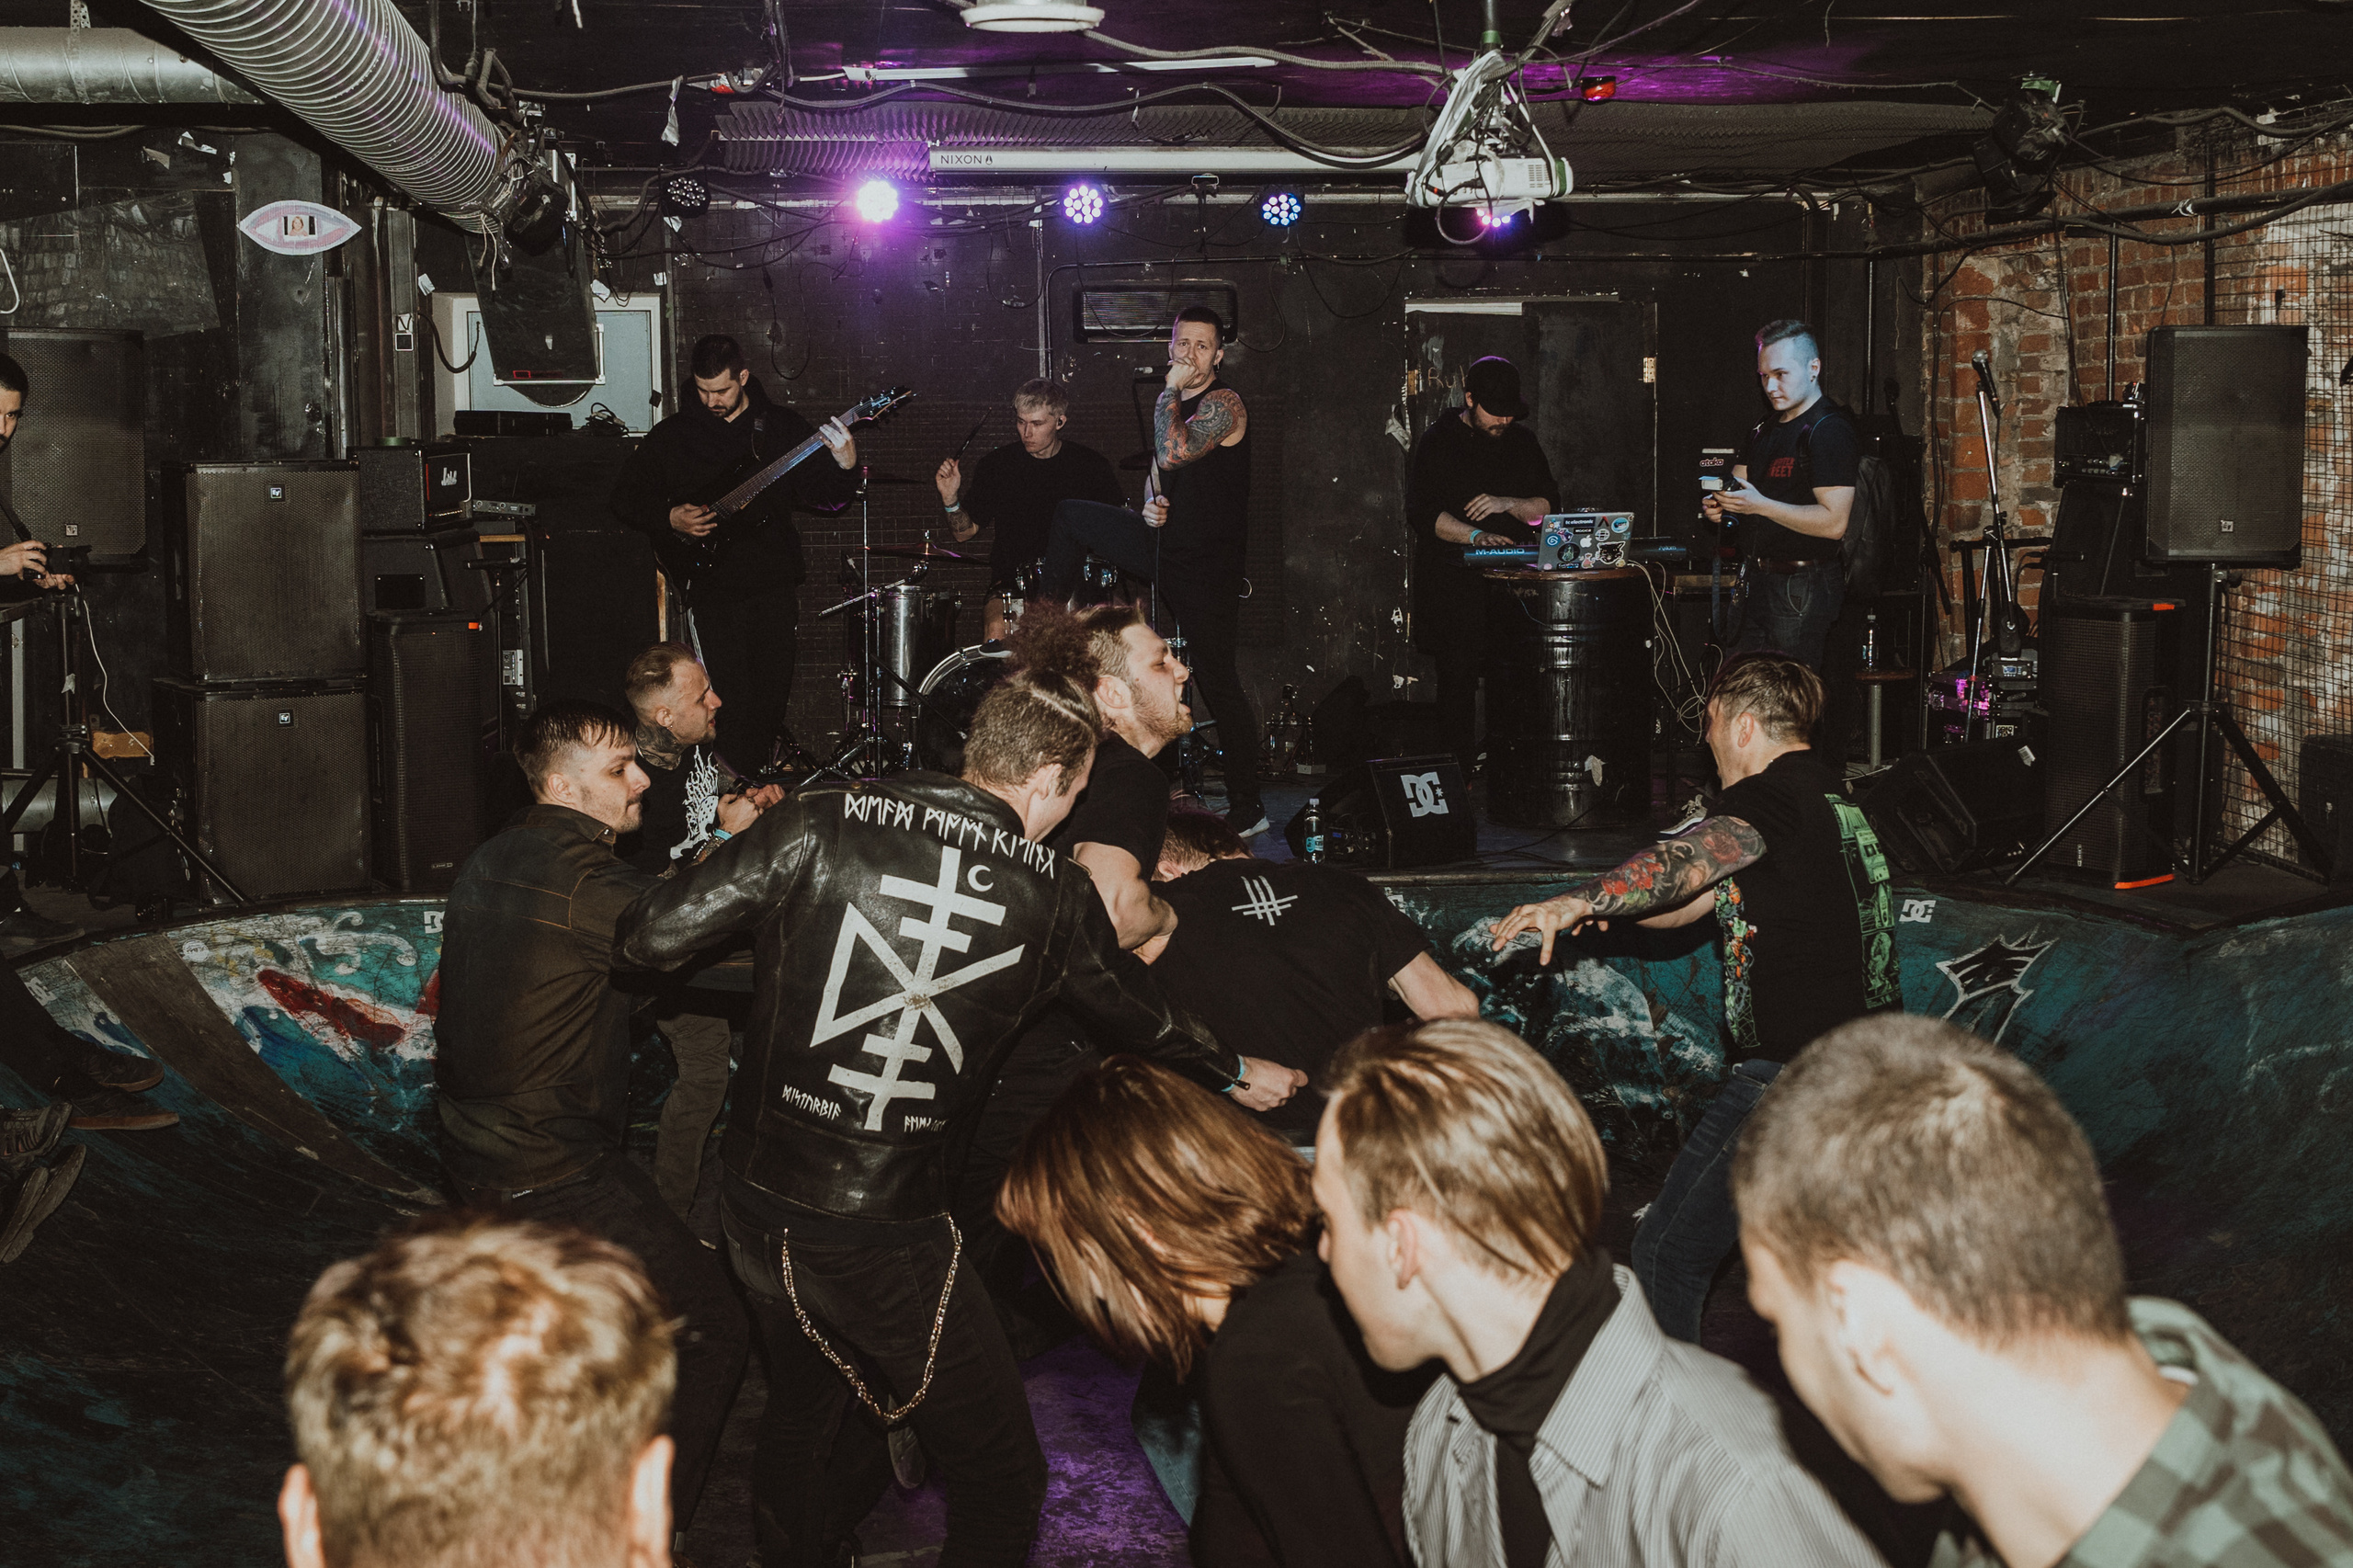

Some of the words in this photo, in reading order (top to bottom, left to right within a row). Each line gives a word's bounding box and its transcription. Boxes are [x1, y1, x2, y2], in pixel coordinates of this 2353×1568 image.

[940, 154, 983, 165] NIXON
[1400, 771, 1449, 818] DC
[1898, 899, 1937, 923] DC
[781, 1085, 842, 1120] DISTURBIA
